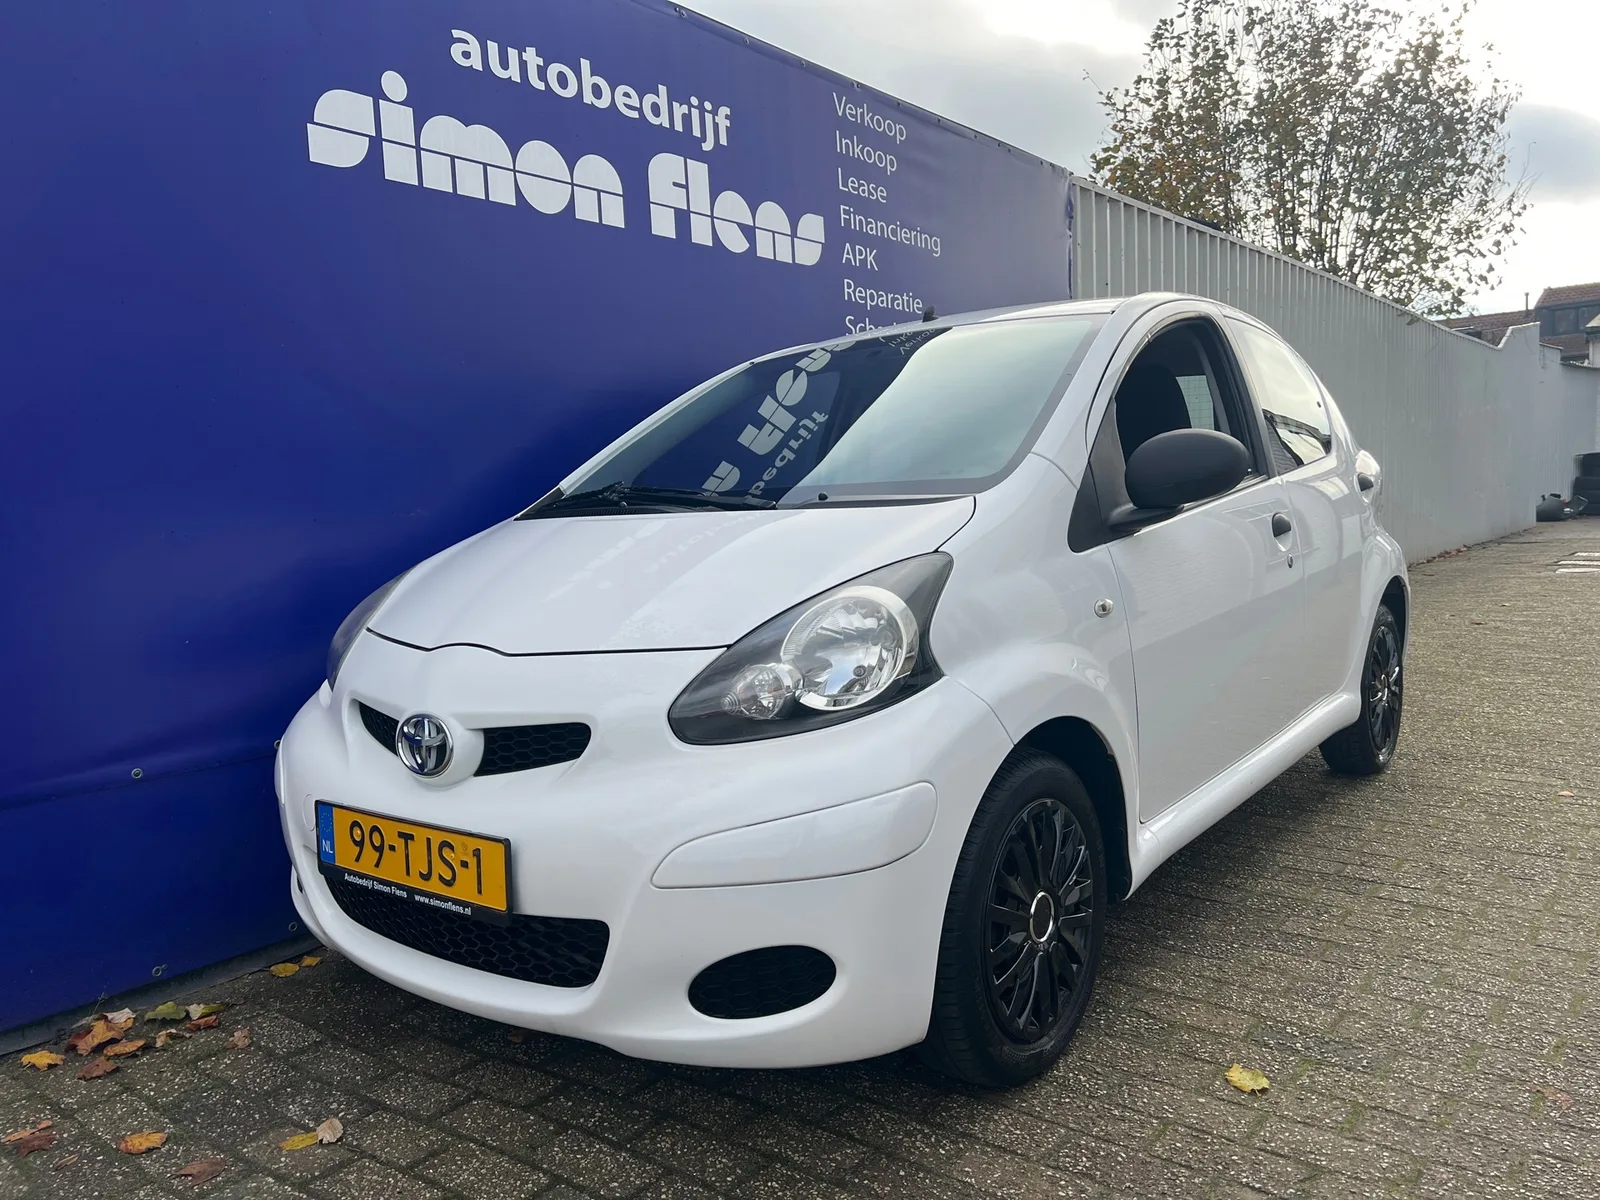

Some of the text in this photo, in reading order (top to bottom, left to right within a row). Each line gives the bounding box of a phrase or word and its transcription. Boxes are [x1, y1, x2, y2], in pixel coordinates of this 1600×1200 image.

[450, 29, 731, 152] autobedrijf
[832, 91, 907, 144] Verkoop
[306, 69, 625, 229] simon
[835, 130, 897, 175] Inkoop
[837, 167, 887, 203] Lease
[840, 204, 941, 257] Financiering
[842, 242, 878, 271] APK
[843, 278, 923, 314] Reparatie
[322, 839, 334, 854] NL
[349, 819, 483, 896] 99-TJS-1
[344, 872, 372, 890] Autobedrijf
[373, 880, 391, 894] Simon
[414, 893, 472, 916] www.simonflens.nl
